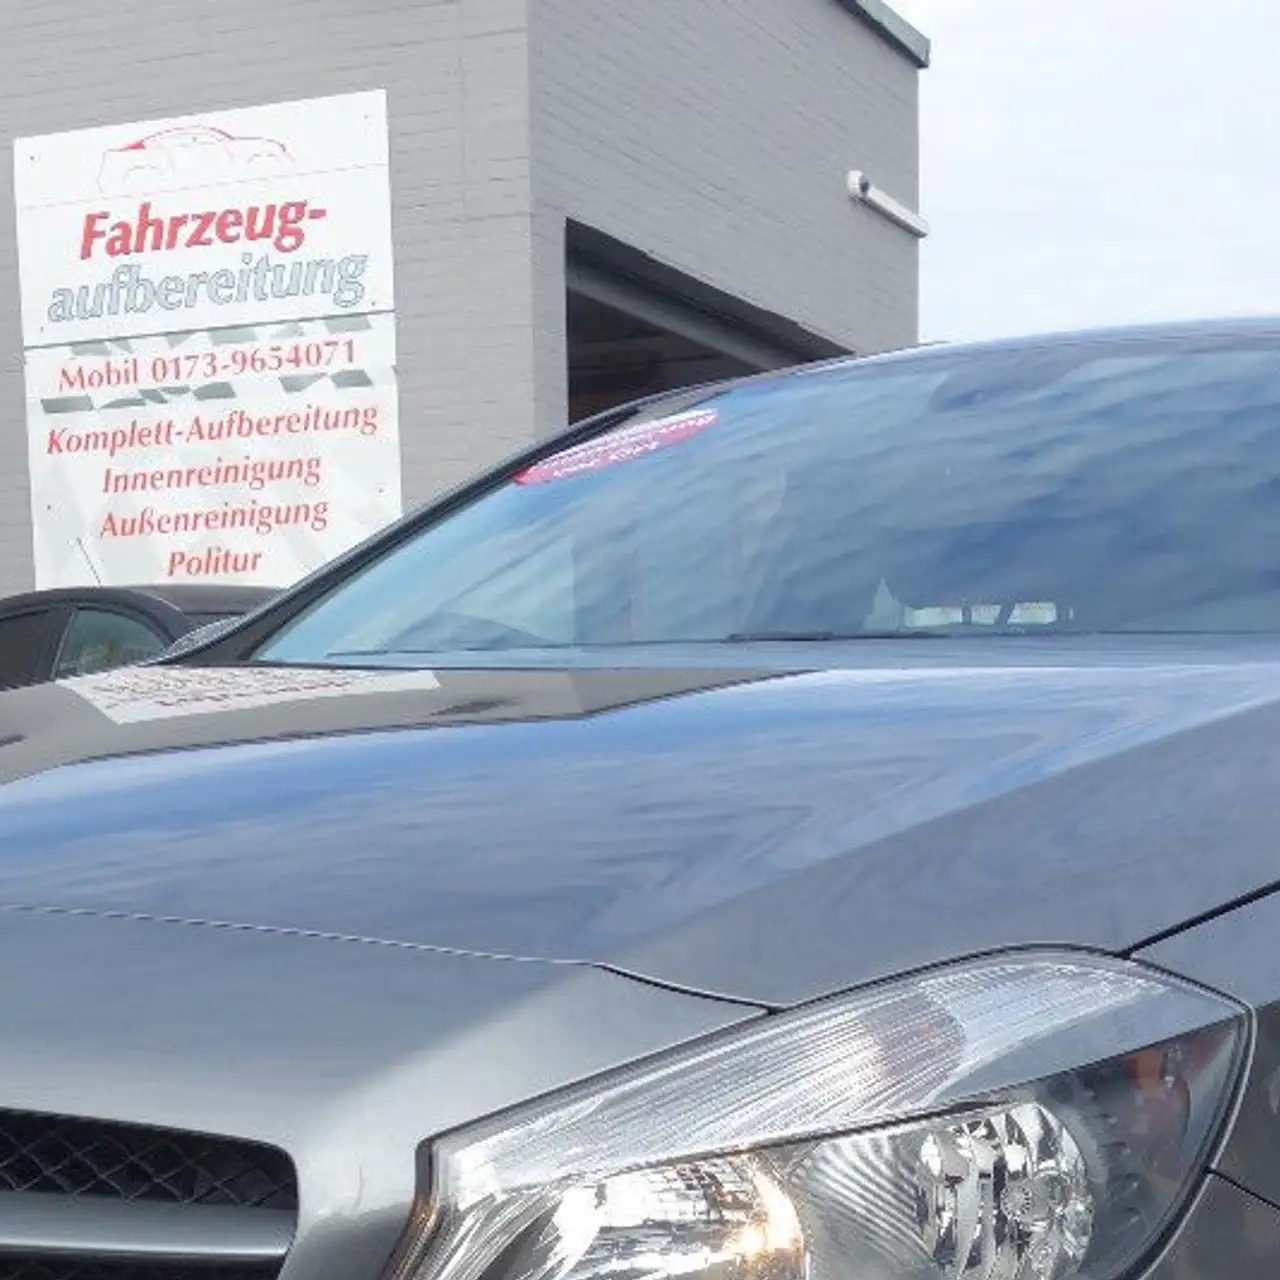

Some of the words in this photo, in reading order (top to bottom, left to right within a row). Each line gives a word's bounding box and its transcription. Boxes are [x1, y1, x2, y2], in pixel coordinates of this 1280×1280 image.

[79, 199, 327, 260] Fahrzeug-
[46, 252, 369, 322] aufbereitung
[58, 358, 138, 391] Mobil
[151, 338, 355, 382] 0173-9654071
[46, 404, 378, 456] Komplett-Aufbereitung
[102, 455, 322, 493] Innenreinigung
[100, 500, 329, 537] Außenreinigung
[167, 549, 262, 577] Politur
